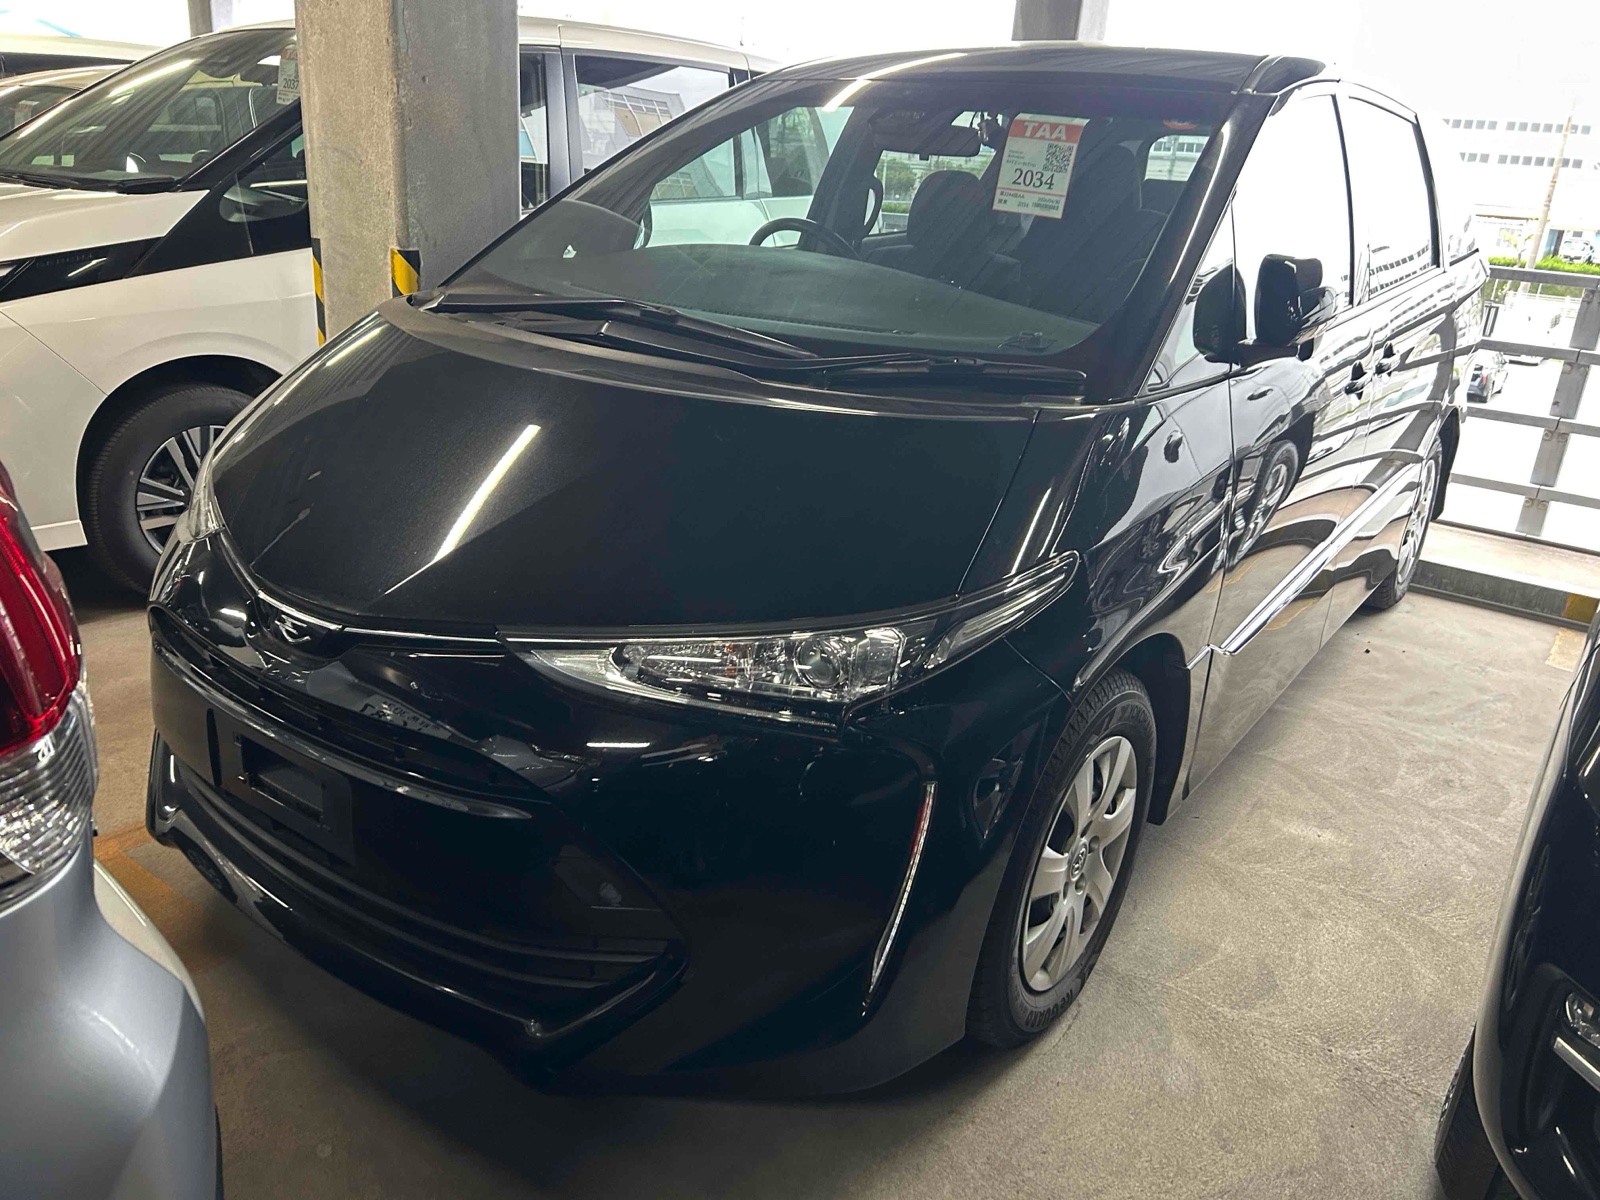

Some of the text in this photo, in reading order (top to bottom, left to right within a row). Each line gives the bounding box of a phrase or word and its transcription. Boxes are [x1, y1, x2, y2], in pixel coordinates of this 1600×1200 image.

[283, 78, 300, 90] 2037
[1023, 121, 1067, 141] TAA
[1012, 168, 1055, 190] 2034
